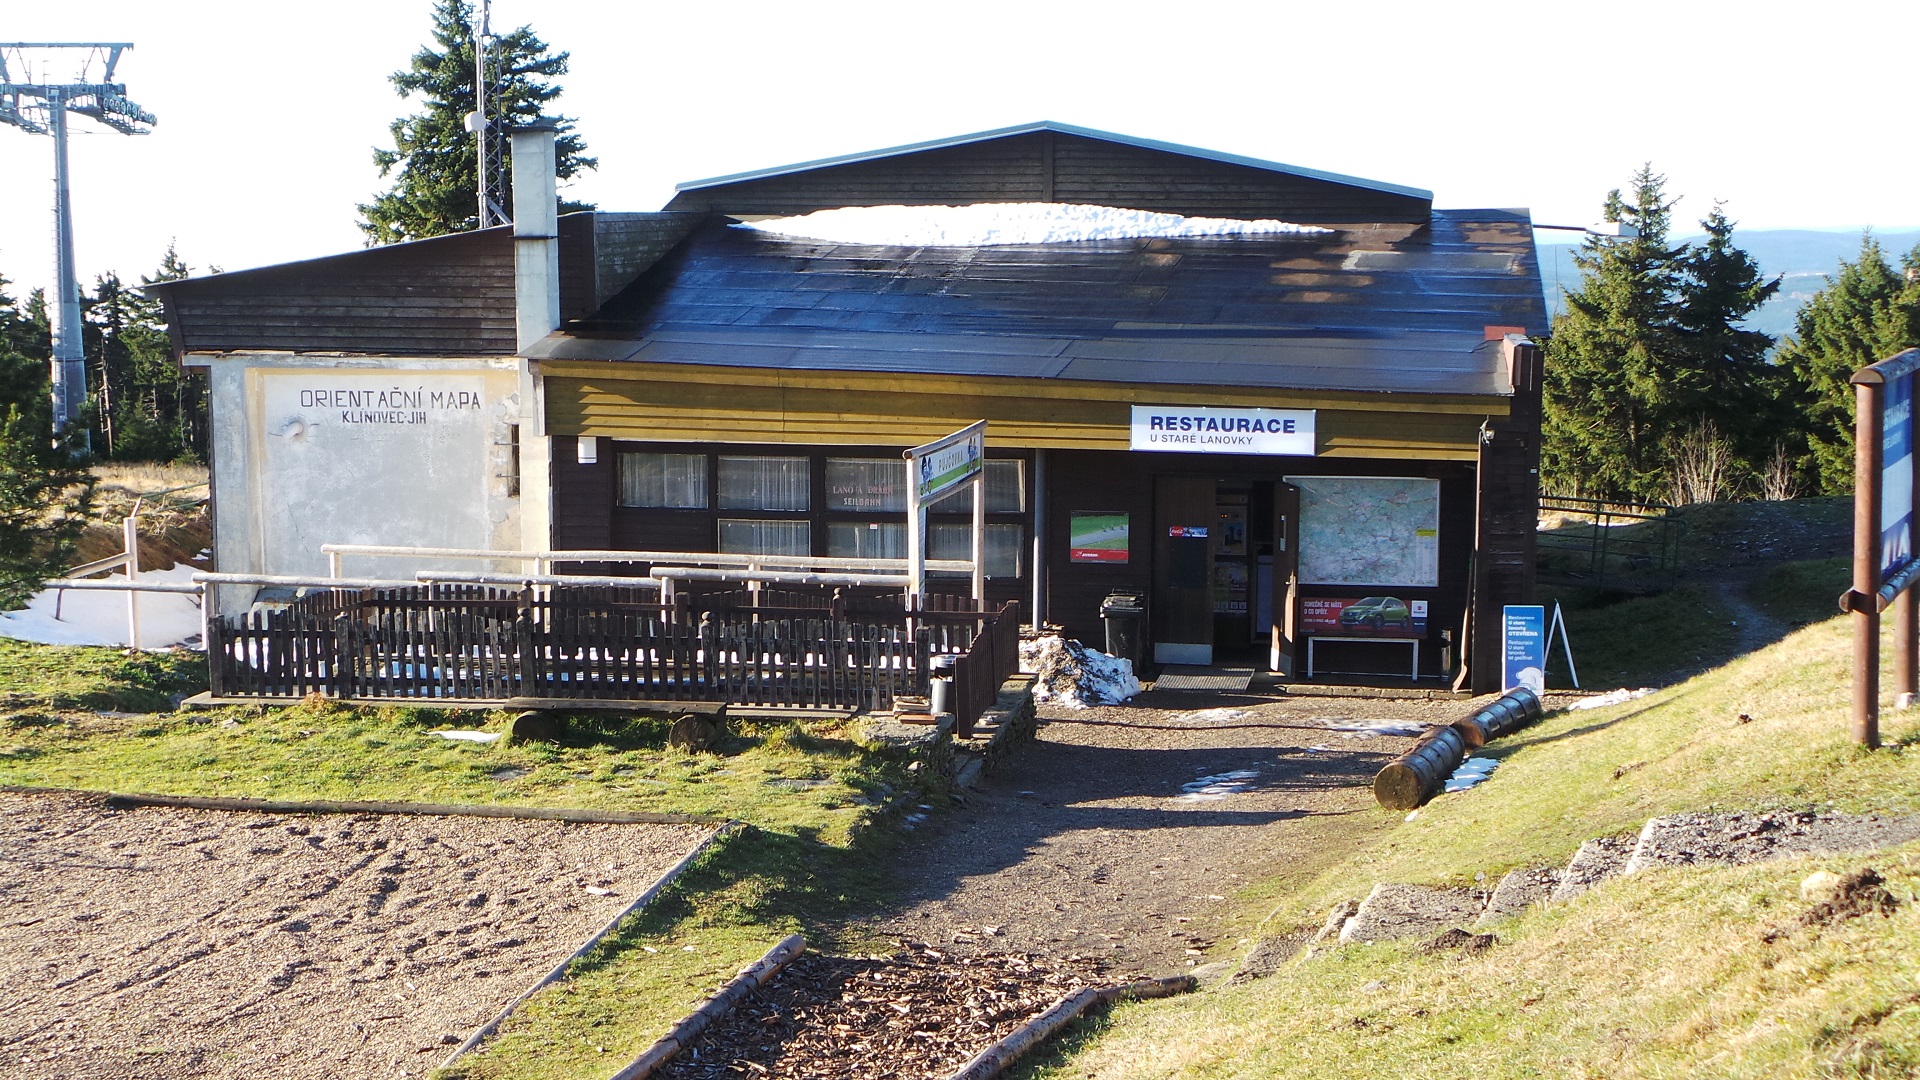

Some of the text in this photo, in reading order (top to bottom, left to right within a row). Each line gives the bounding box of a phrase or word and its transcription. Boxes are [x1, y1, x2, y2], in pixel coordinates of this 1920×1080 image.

[300, 386, 482, 410] ORIENTAČNÍ MAPA
[1150, 415, 1296, 434] RESTAURACE
[1150, 433, 1253, 445] U STARÉ LANOVKY
[843, 497, 881, 507] SEILBAHN
